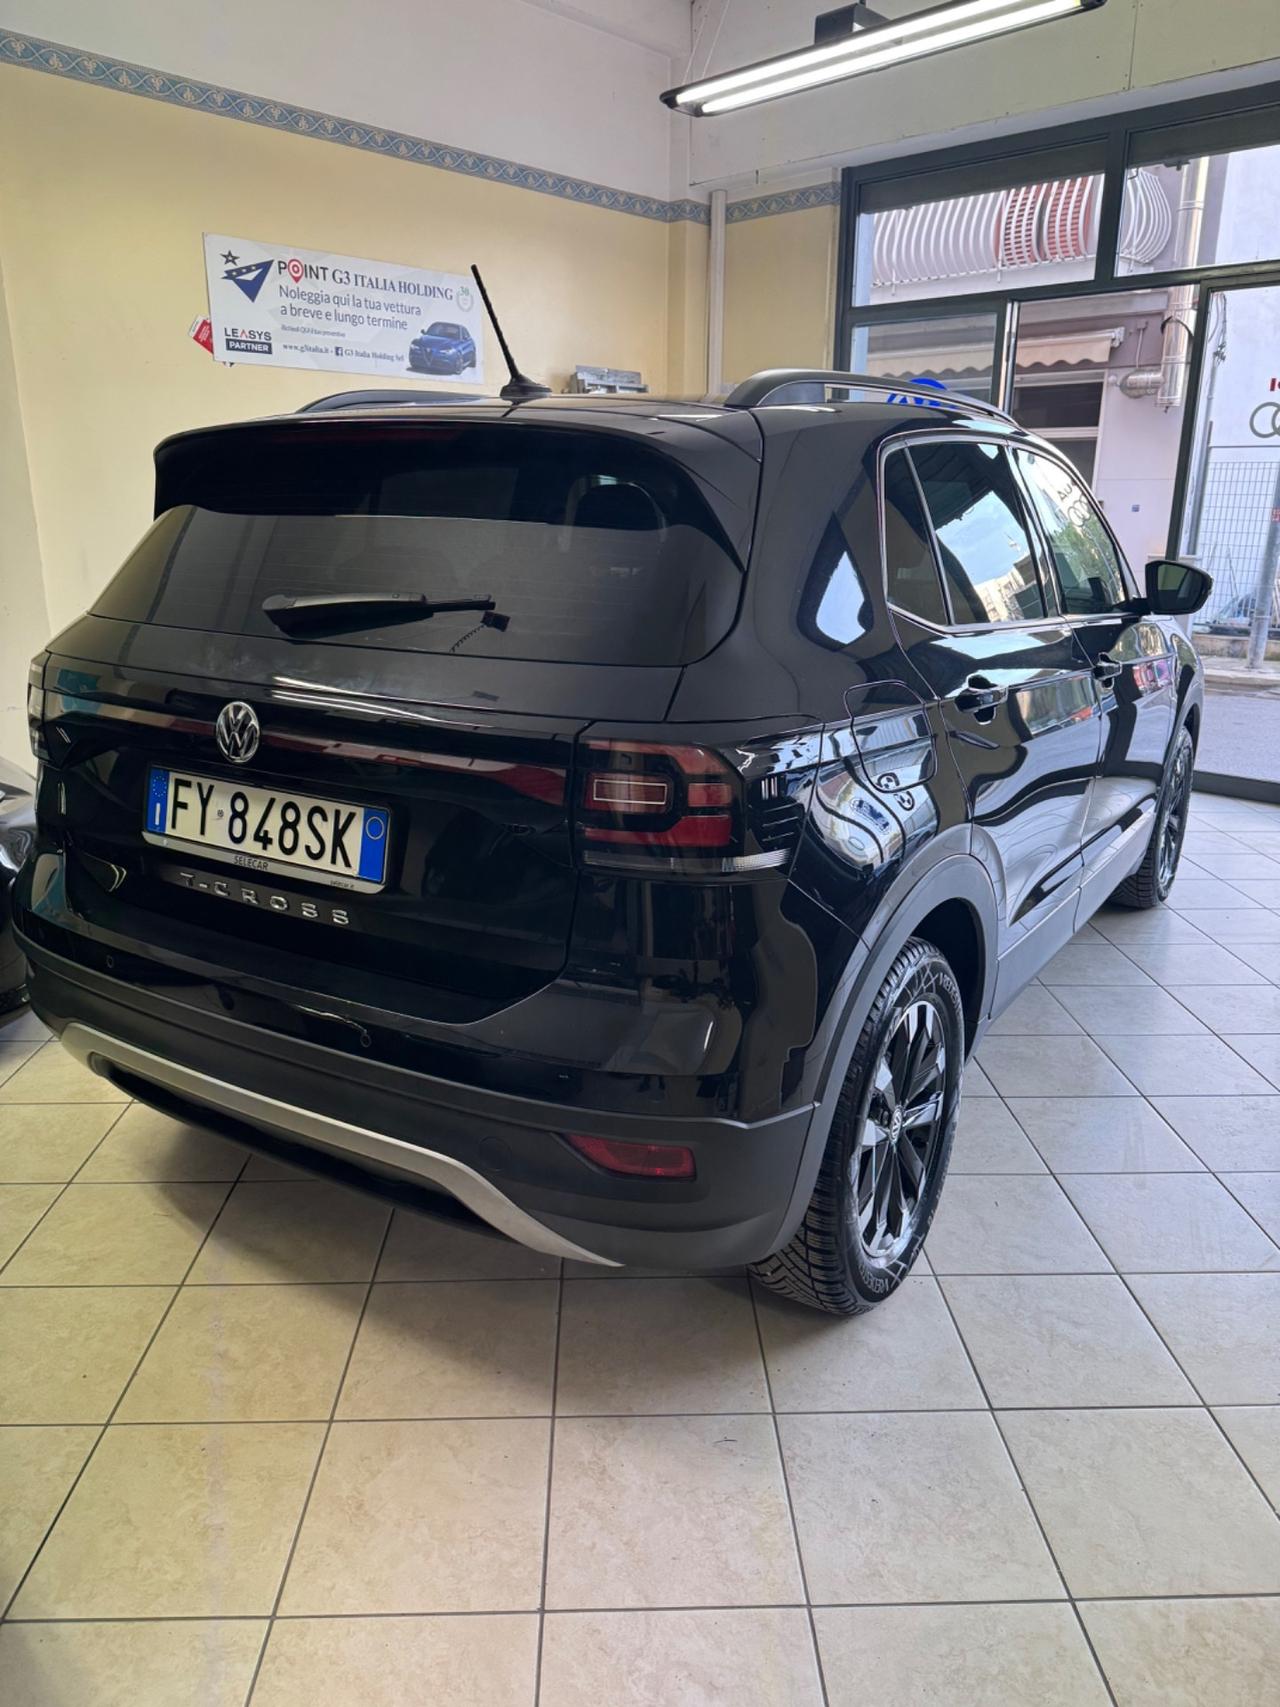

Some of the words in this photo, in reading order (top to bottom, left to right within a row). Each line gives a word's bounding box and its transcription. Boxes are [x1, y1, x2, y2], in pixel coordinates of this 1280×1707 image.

[278, 258, 329, 283] POINT
[332, 269, 351, 286] G3
[354, 274, 396, 292] ITALIA
[398, 281, 454, 301] HOLDING
[279, 285, 331, 305] Noleggia
[333, 293, 350, 307] qui
[352, 295, 362, 308] la
[364, 298, 381, 311] tua
[383, 302, 422, 316] vettura
[280, 305, 287, 315] a
[290, 304, 323, 320] breve
[325, 311, 332, 321] e
[334, 310, 365, 327] lungo
[367, 315, 408, 330] termine
[224, 328, 272, 341] LEASYS
[229, 341, 269, 352] PARTNER
[354, 351, 371, 359] Italia
[371, 352, 395, 362] Holding
[171, 777, 215, 836] FY
[228, 791, 357, 869] 848SK
[233, 855, 269, 872] SELECAR
[180, 872, 350, 925] T-CROSS
